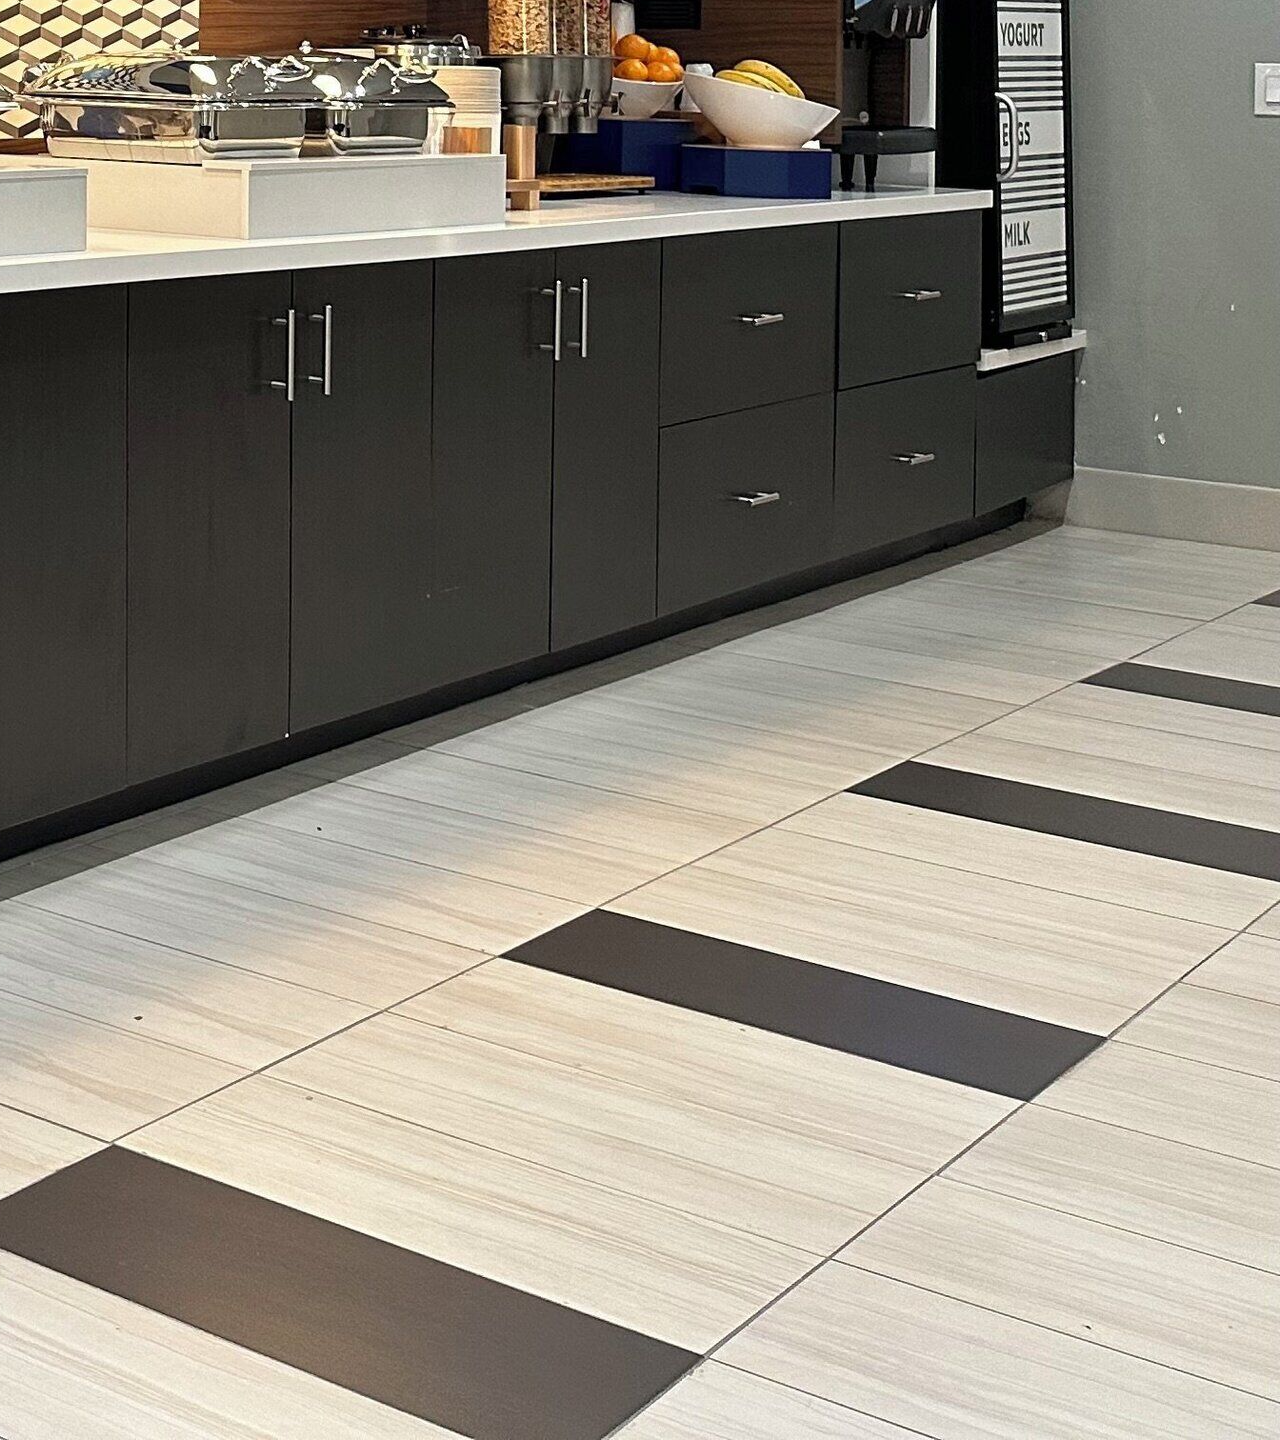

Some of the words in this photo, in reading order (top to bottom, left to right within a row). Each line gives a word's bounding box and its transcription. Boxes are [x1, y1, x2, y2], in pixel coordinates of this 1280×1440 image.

[1000, 22, 1045, 47] YOGURT
[1002, 121, 1031, 147] EGS
[1004, 220, 1031, 248] MILK
